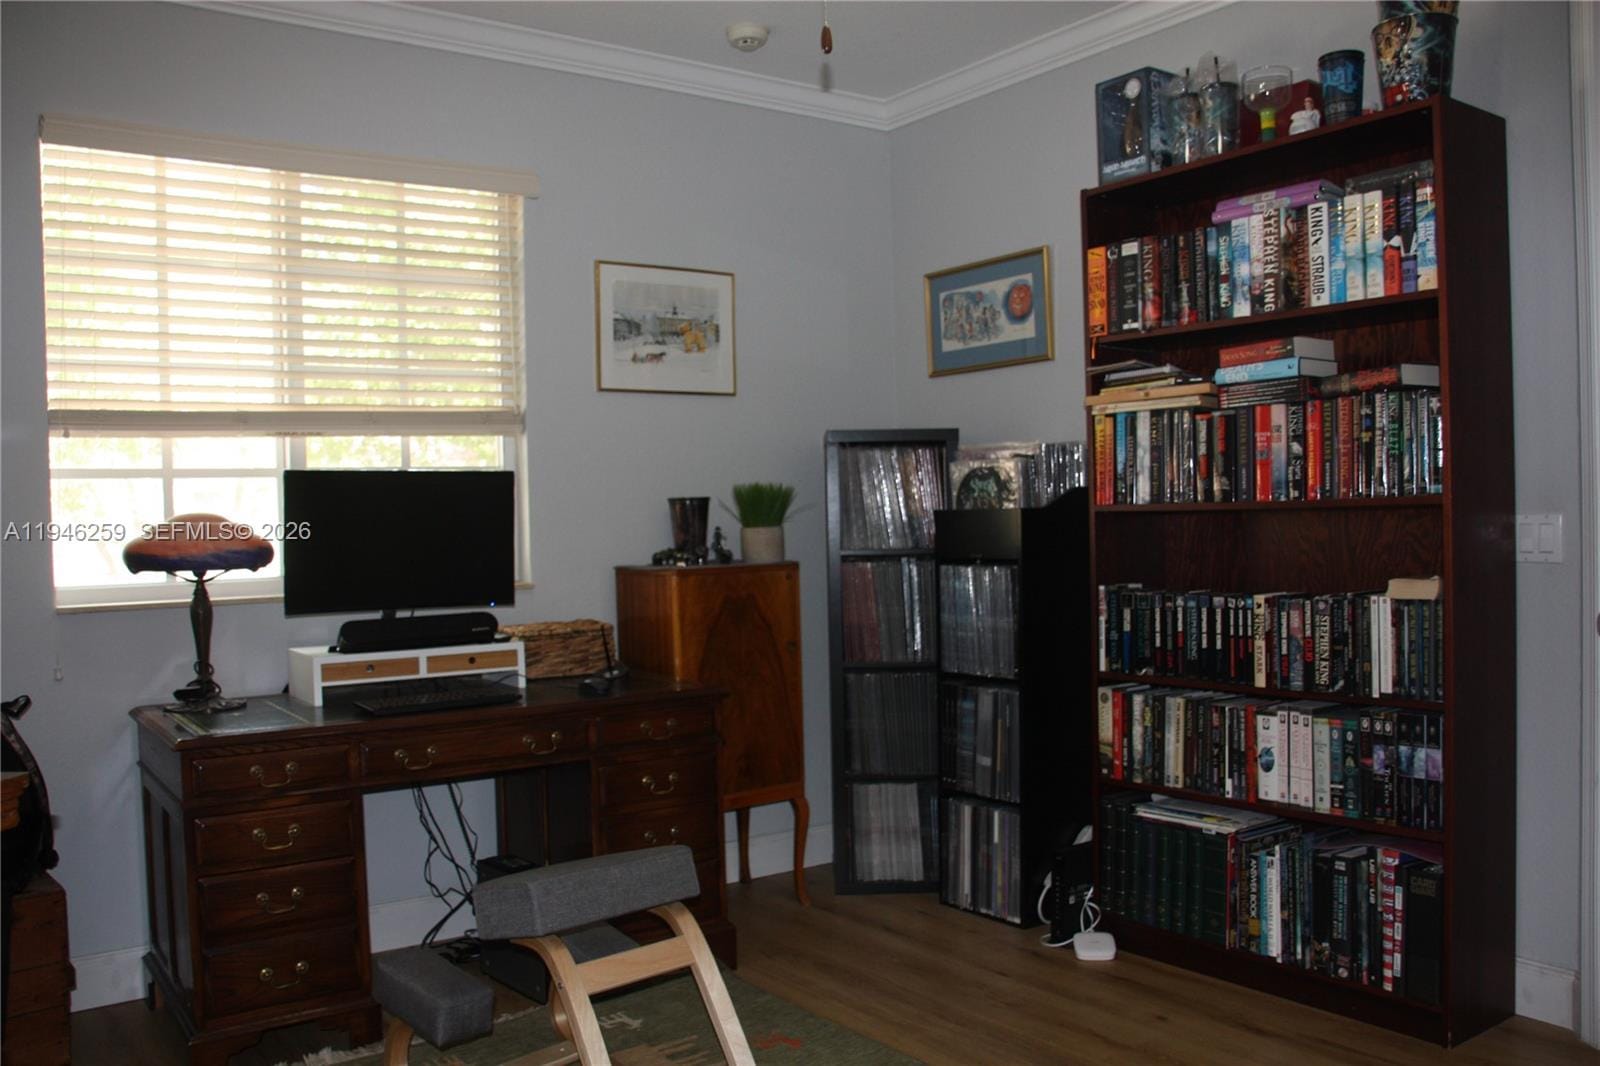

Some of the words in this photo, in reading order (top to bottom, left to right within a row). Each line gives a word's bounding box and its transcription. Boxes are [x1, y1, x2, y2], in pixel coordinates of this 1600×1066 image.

[1310, 206, 1325, 238] KING
[1383, 198, 1397, 231] KING
[1400, 195, 1413, 228] KING
[1218, 235, 1231, 276] STEPHEN
[1263, 209, 1276, 274] STEPHEN
[1143, 244, 1153, 281] KING
[1311, 255, 1326, 295] STRAUB
[1219, 283, 1232, 309] KING
[1263, 279, 1276, 313] KING
[1289, 405, 1298, 436] KING
[1389, 423, 1399, 456] BLAZE
[1319, 615, 1330, 660] STEPHEN
[1255, 645, 1264, 675] STARK
[1319, 660, 1330, 685] KING
[1248, 858, 1258, 893] ANSWER
[1249, 894, 1258, 919] BOOK
